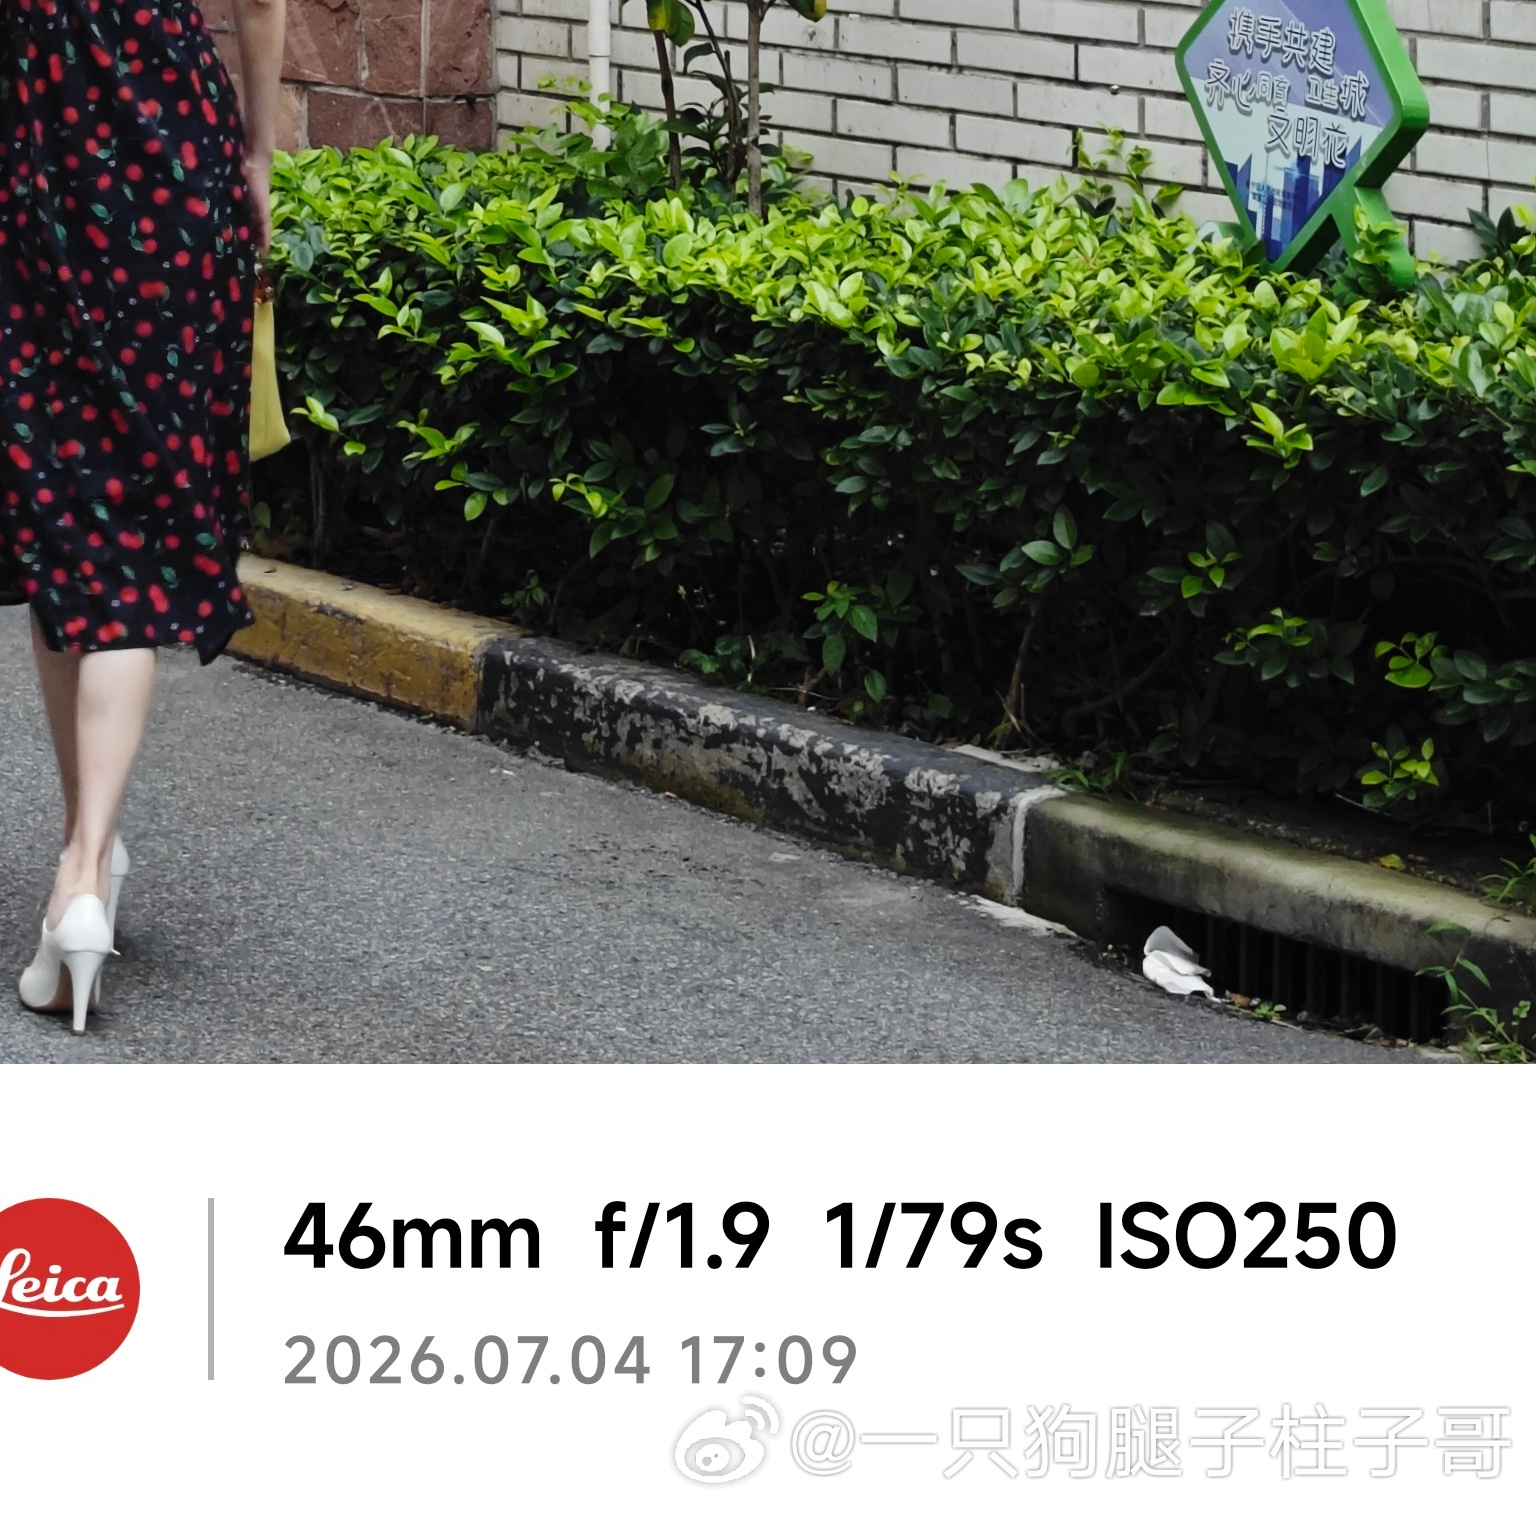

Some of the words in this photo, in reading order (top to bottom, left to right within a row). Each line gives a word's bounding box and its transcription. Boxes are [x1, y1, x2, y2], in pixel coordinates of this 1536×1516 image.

[1228, 6, 1337, 75] 携手共建
[1204, 58, 1292, 114] 齐心同育
[1305, 70, 1370, 118] 卫生城
[1265, 105, 1350, 168] 文明花
